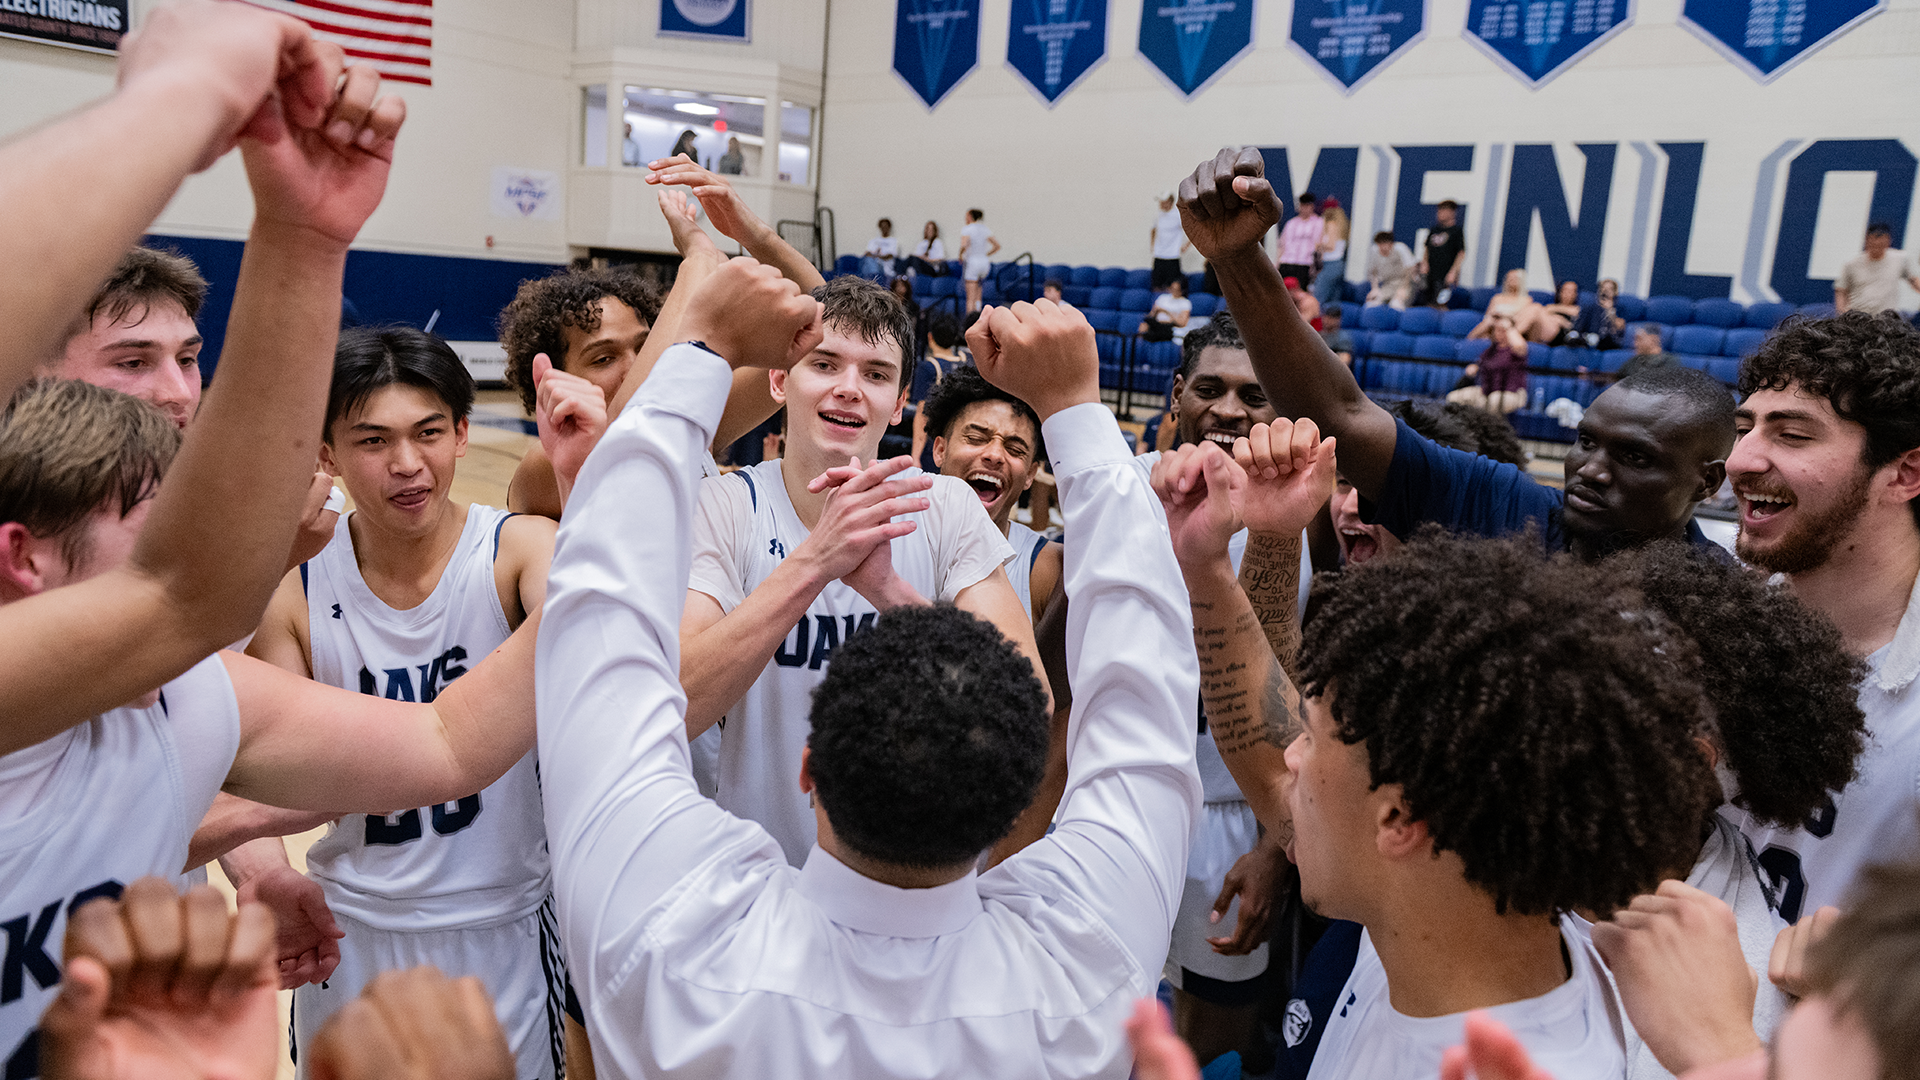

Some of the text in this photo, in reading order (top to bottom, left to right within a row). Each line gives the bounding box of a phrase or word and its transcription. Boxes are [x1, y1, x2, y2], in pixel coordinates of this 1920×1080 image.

[0, 0, 120, 30] LECTRICIANS
[1242, 139, 1918, 302] MENLO
[1245, 567, 1299, 591] Rush
[1272, 587, 1283, 595] TO
